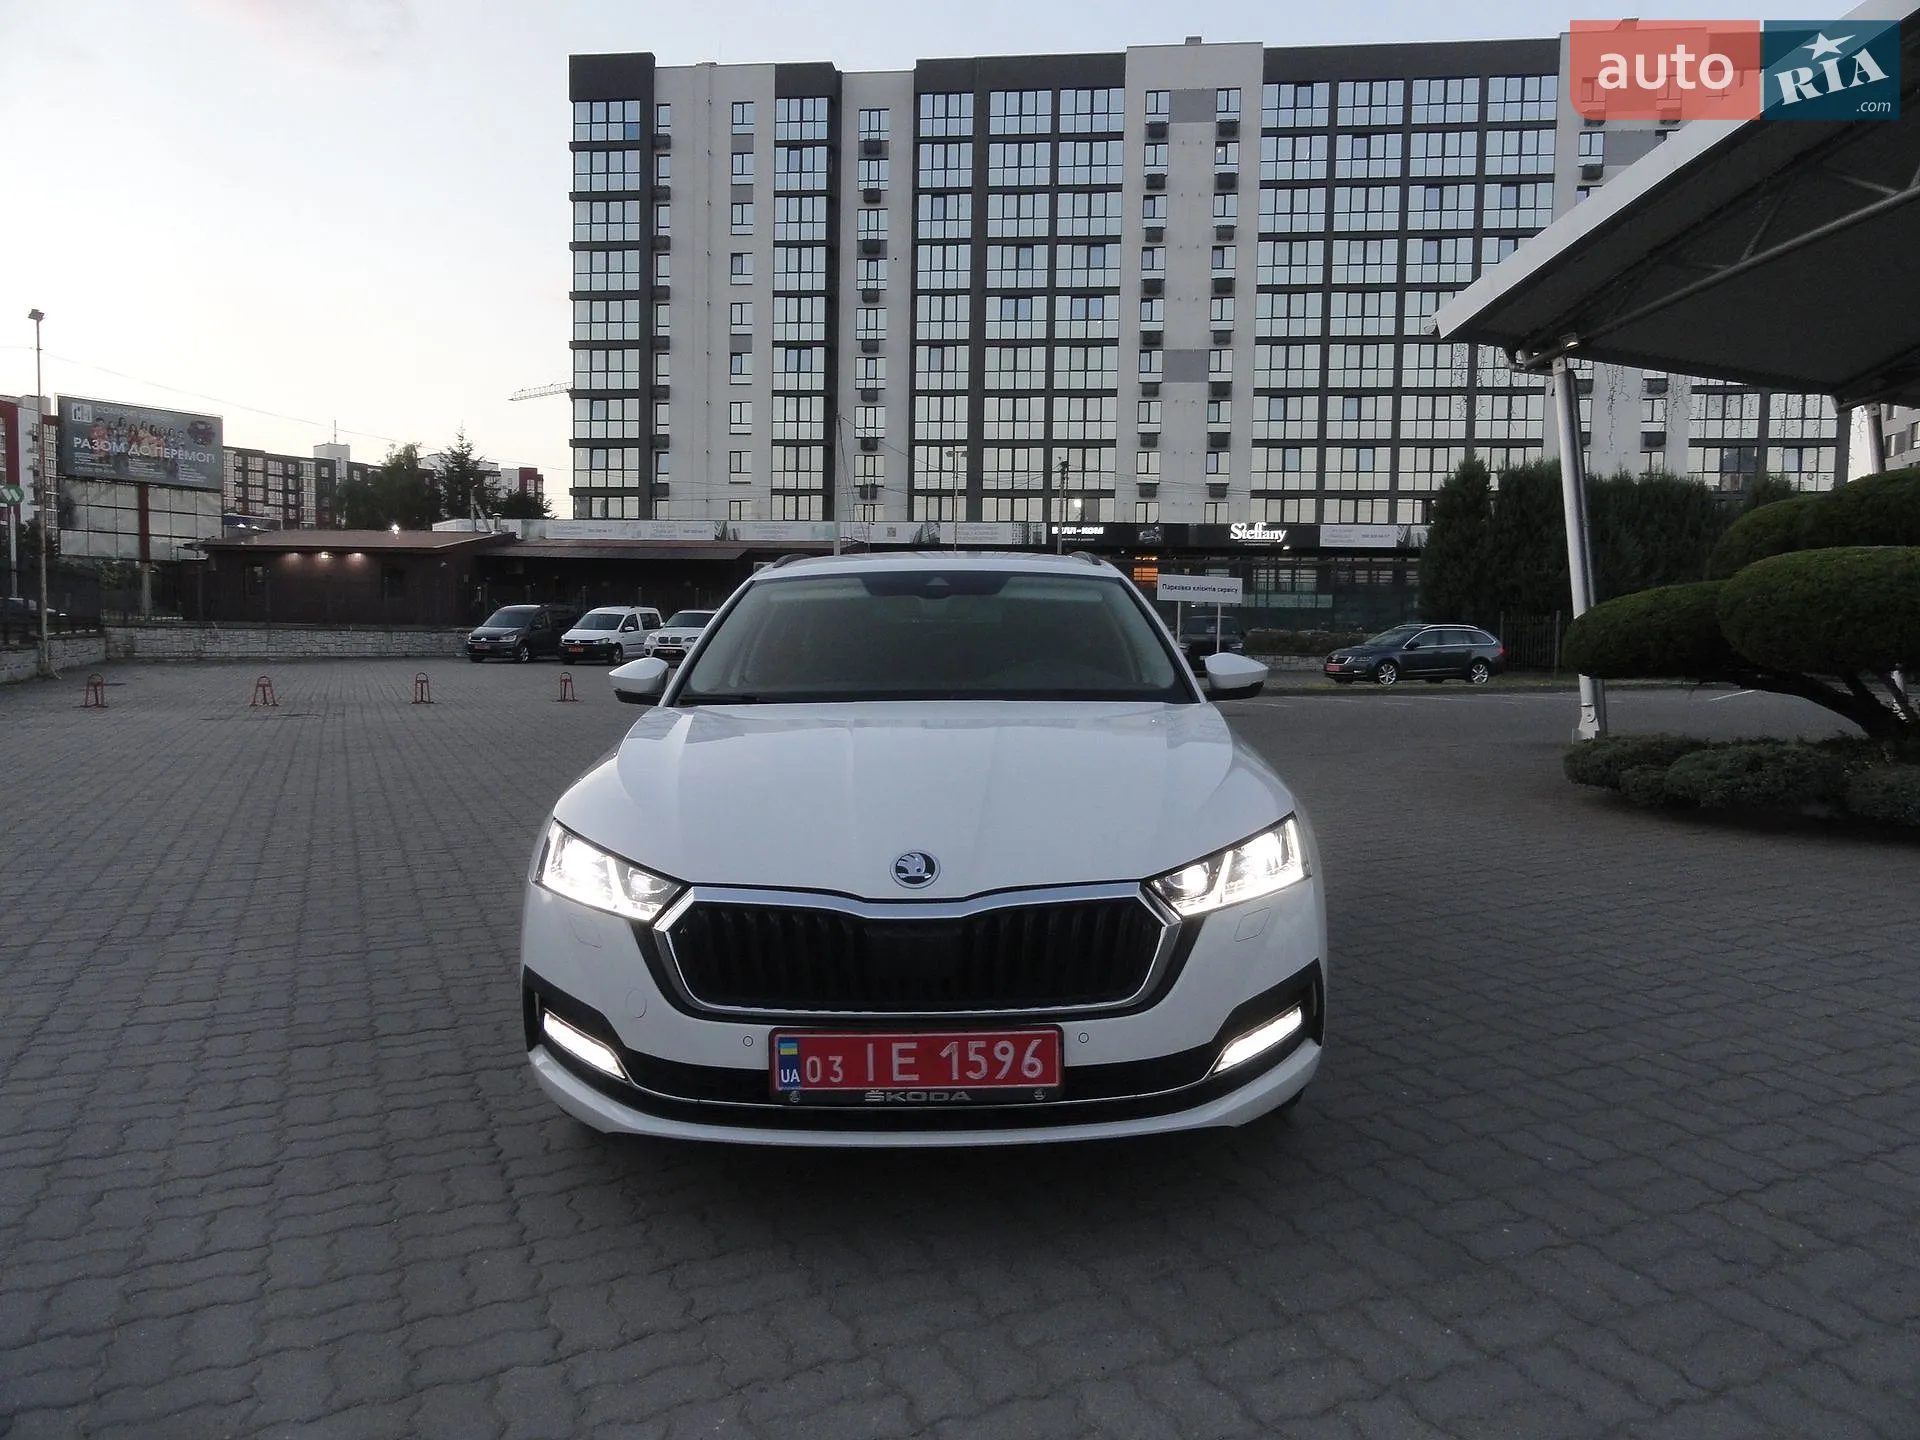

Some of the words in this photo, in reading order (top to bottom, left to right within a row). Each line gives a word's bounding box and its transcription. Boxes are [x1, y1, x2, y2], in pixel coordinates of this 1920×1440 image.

[73, 437, 125, 453] РАЗОМ
[128, 443, 151, 457] ДО
[1230, 522, 1287, 543] Steffany
[1162, 583, 1192, 592] Парковка
[806, 1056, 844, 1083] 03
[939, 1039, 1044, 1081] 1596
[781, 1068, 801, 1083] UA
[864, 1089, 972, 1103] ŠKODA
